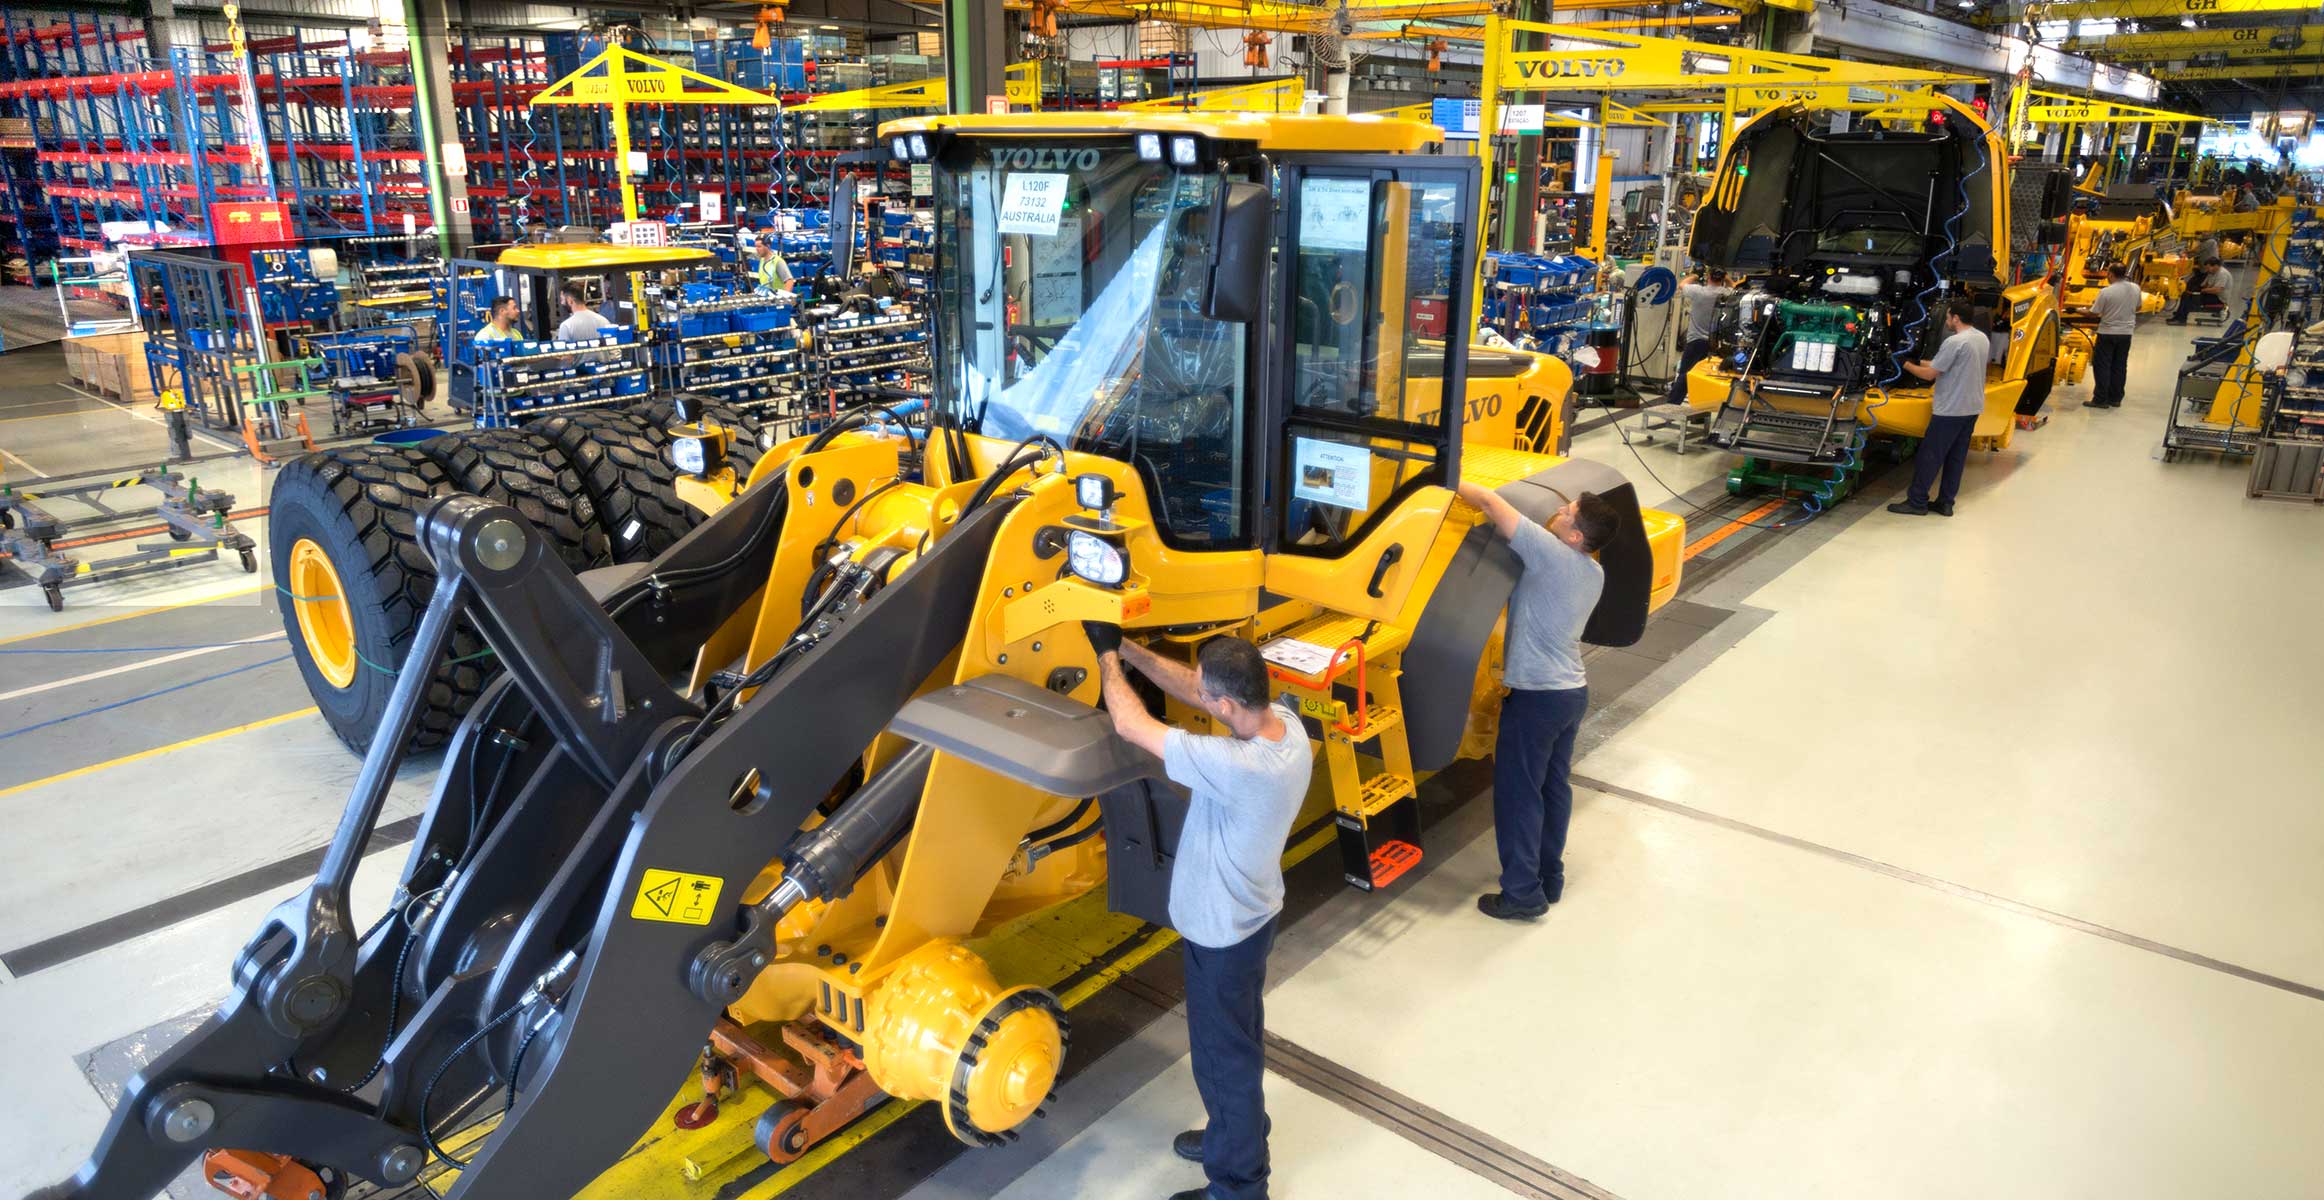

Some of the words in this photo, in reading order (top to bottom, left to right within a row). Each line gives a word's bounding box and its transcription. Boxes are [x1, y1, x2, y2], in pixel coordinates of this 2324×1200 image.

[2232, 29, 2259, 41] GH
[1515, 58, 1626, 78] VOLVO
[627, 79, 665, 94] VOLVO
[2046, 109, 2090, 118] VOLVO
[990, 147, 1101, 171] VOLVO
[1022, 181, 1050, 192] L120F
[1019, 196, 1047, 208] 73132
[1001, 211, 1057, 225] AUSTRALIA
